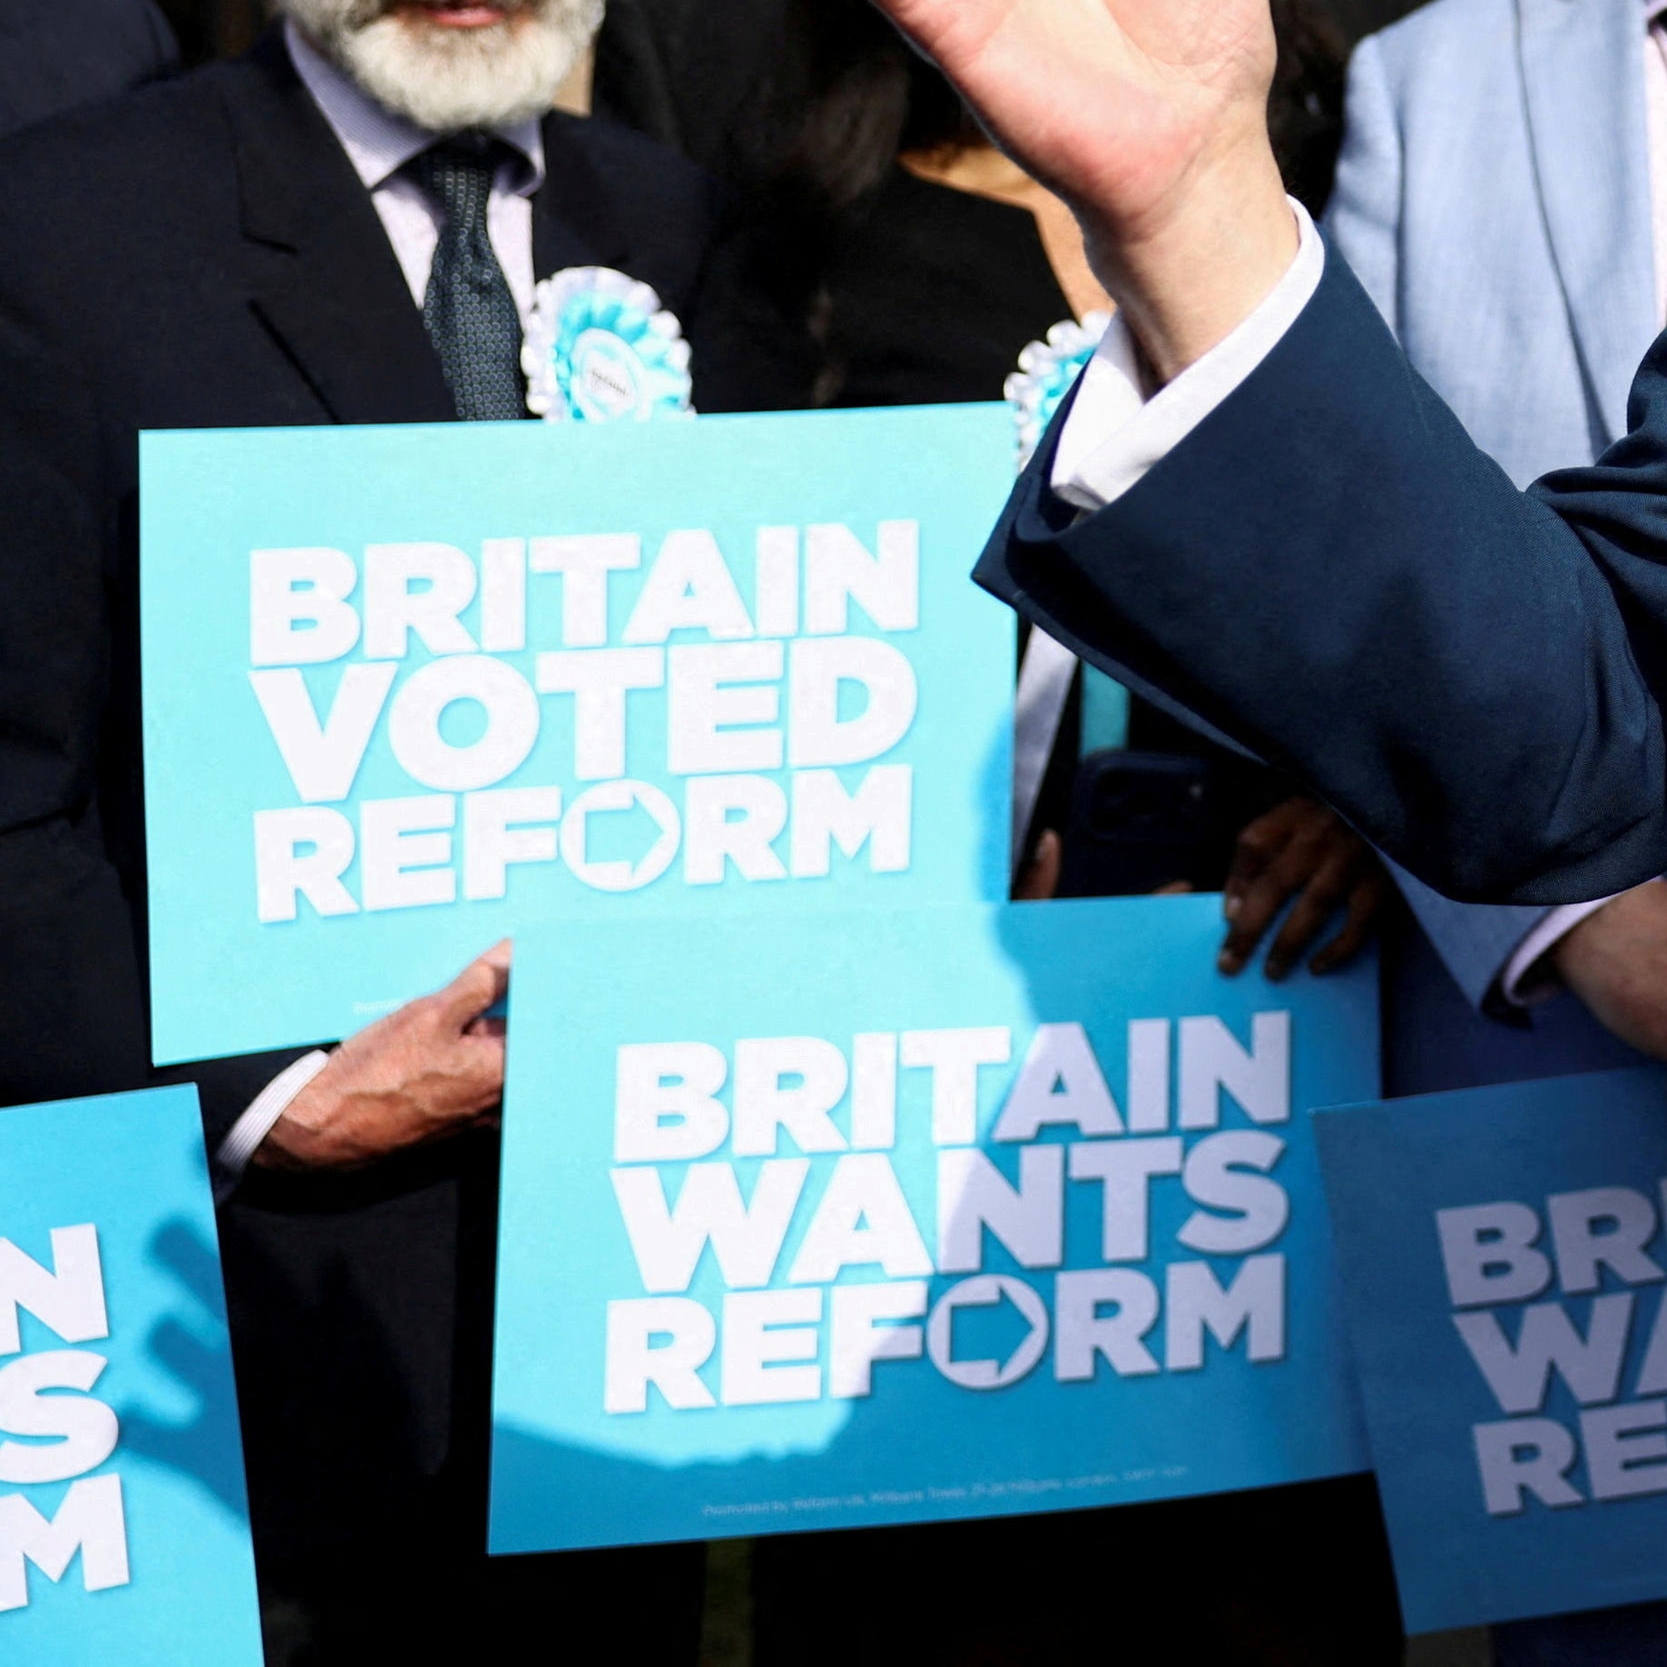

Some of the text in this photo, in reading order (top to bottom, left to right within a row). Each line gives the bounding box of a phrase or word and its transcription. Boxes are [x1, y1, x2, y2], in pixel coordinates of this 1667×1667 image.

[248, 519, 919, 667] BRITAIN
[248, 636, 918, 804] VOTED
[254, 764, 913, 923] REFORM
[612, 1009, 1291, 1164] BRITAIN
[610, 1130, 1290, 1295] WANTS
[604, 1253, 1286, 1415] REFORM
